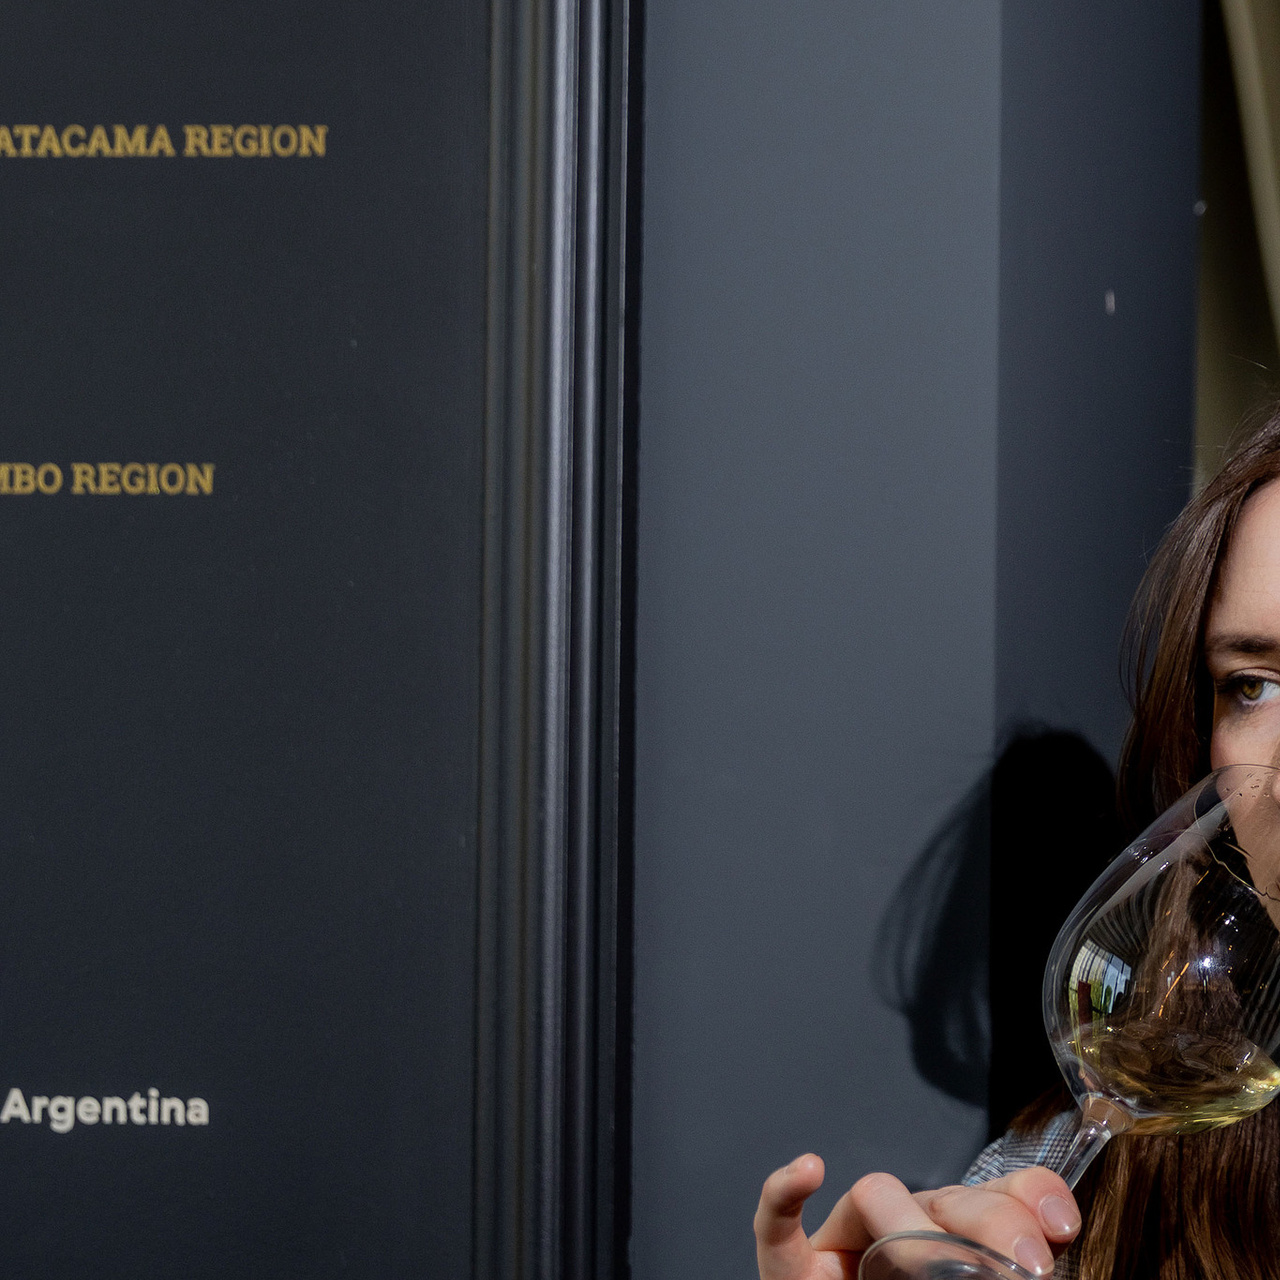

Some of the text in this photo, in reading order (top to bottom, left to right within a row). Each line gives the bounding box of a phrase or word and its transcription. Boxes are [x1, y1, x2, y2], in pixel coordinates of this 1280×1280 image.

[182, 124, 328, 158] REGION
[0, 462, 215, 495] BO REGION
[0, 1087, 209, 1134] Argentina
